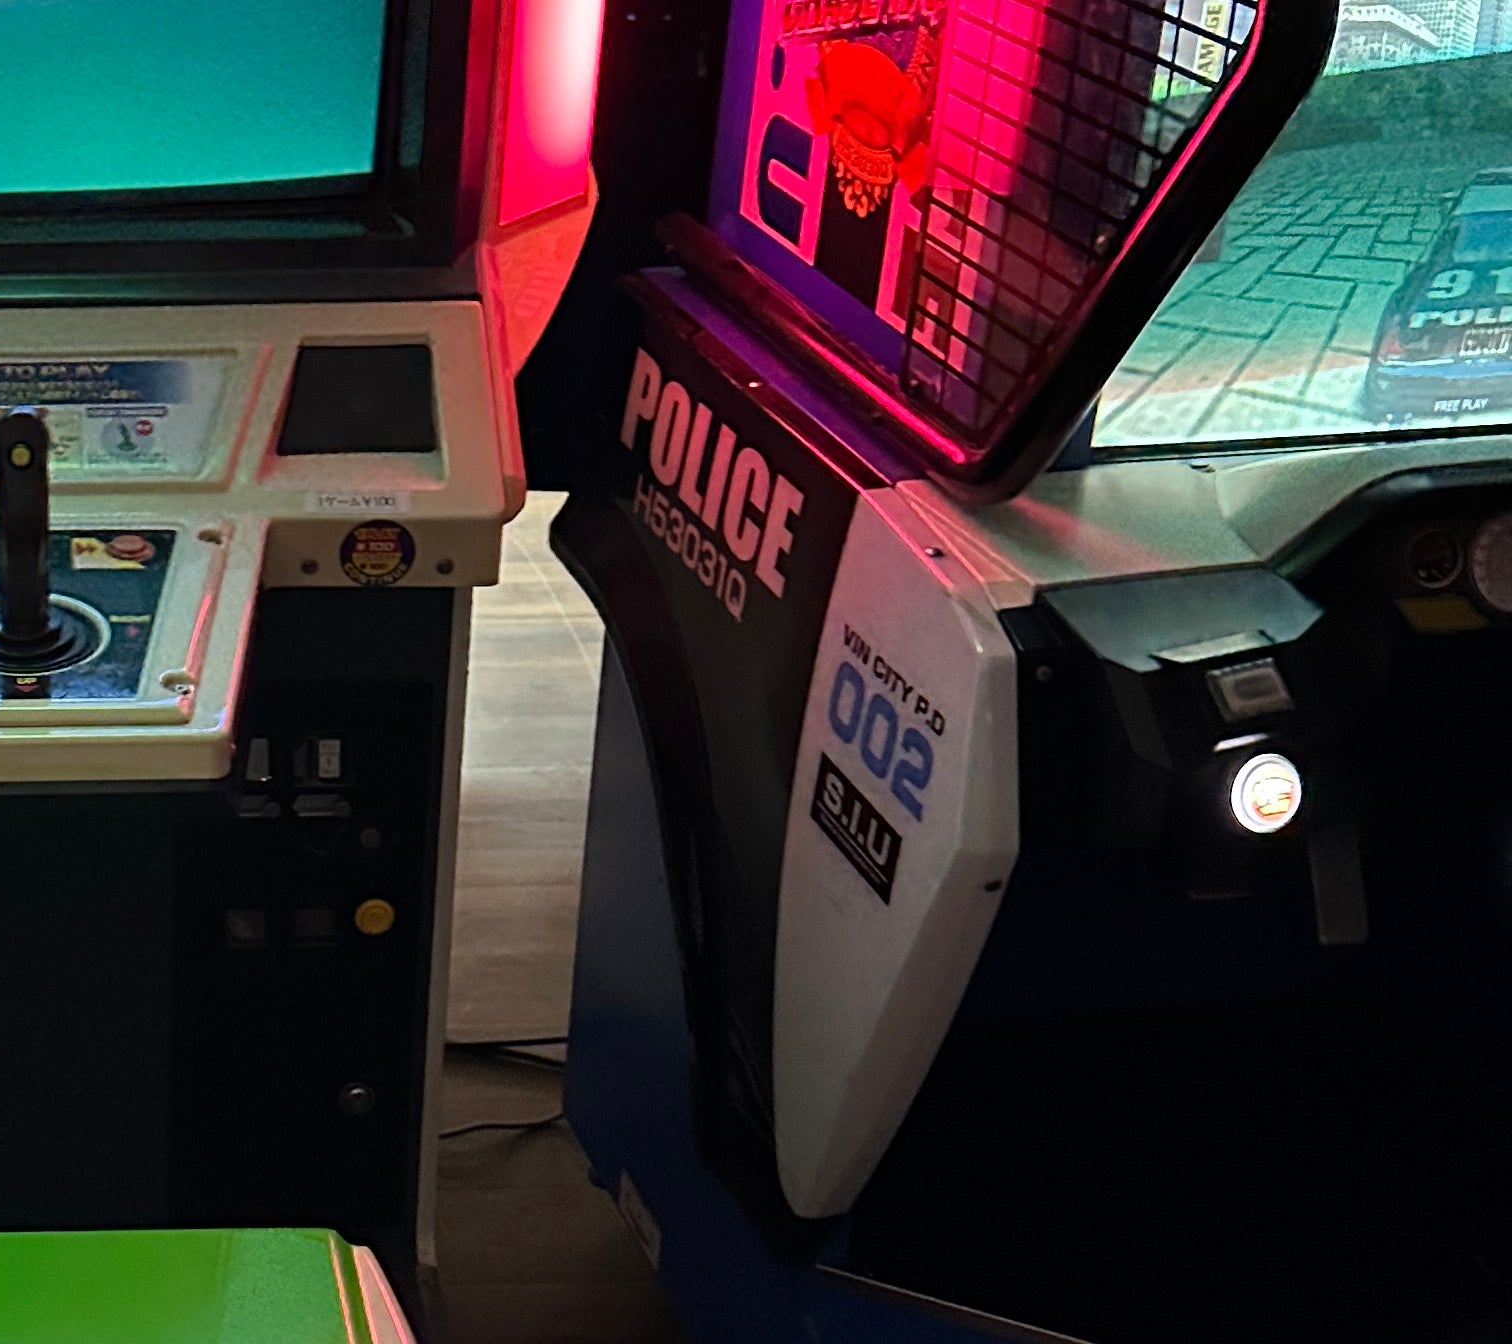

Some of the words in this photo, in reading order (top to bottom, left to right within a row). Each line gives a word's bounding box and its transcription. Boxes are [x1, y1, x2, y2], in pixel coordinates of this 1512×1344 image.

[1433, 399, 1461, 413] FREE
[1461, 397, 1489, 411] PLAY
[620, 346, 805, 600] POLICE
[844, 623, 871, 665] VIN
[872, 656, 913, 702] CITY
[828, 660, 934, 823] 002
[822, 771, 892, 867] S.I.U
